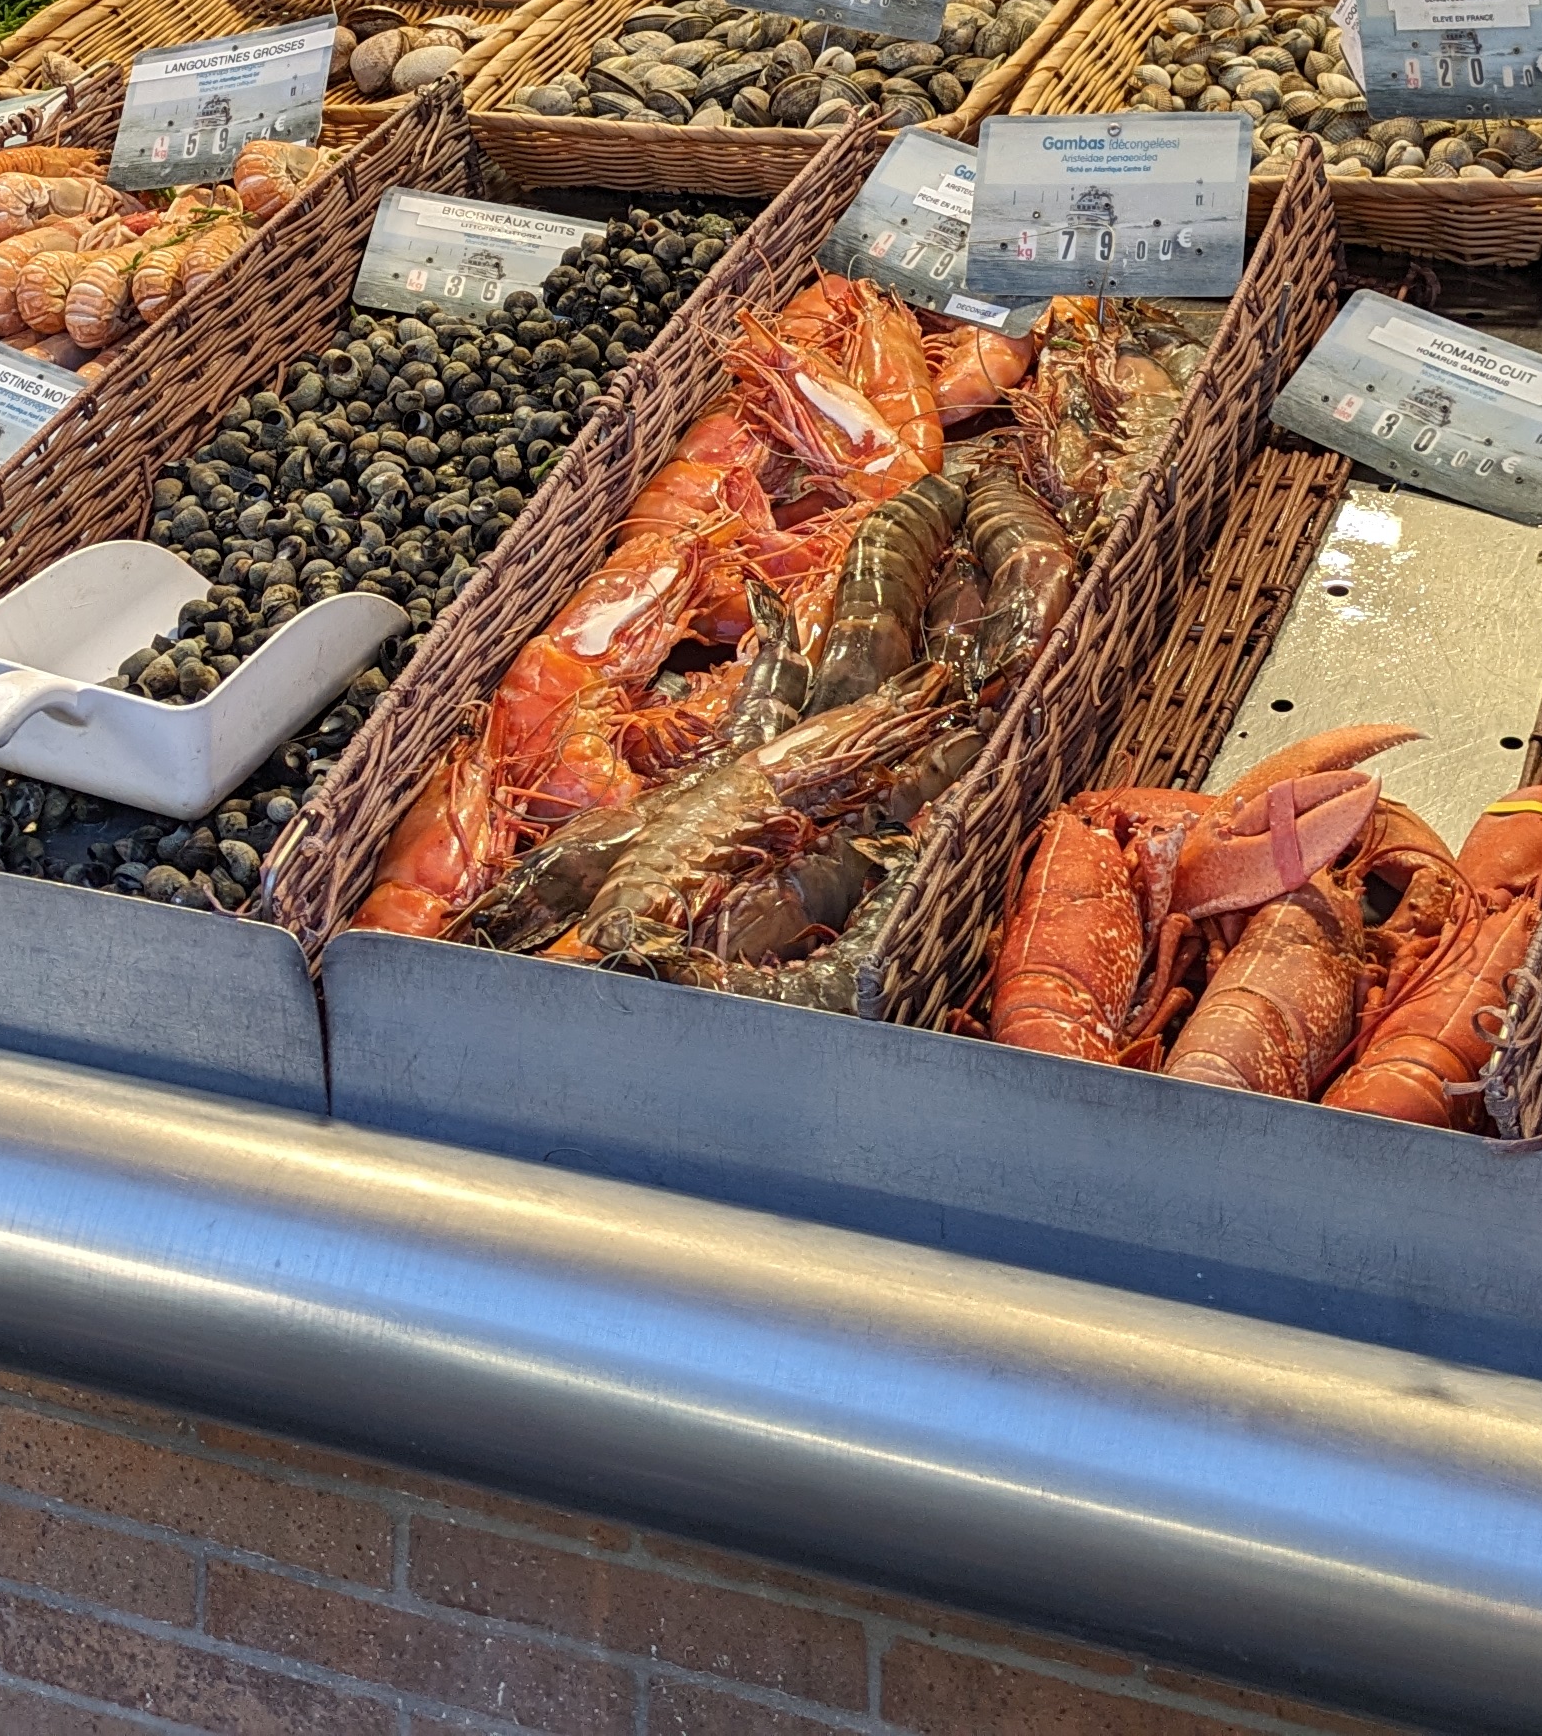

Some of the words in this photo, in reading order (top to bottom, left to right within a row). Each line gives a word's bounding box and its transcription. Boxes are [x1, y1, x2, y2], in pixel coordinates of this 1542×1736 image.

[1432, 14, 1454, 24] ELEVE
[1455, 14, 1466, 22] EN
[1467, 13, 1495, 22] FRANCE
[164, 50, 251, 75] LANGOUSTINES
[253, 37, 307, 60] GROSSES
[1405, 75, 1420, 88] kg
[1042, 135, 1105, 152] Gambas
[1108, 136, 1181, 152] (décongelées)
[153, 147, 167, 160] kg
[1061, 153, 1105, 163] Aristeidae
[441, 206, 531, 230] BIGORNEAUX
[535, 221, 576, 237] CUITS
[1016, 246, 1033, 261] kg
[1415, 345, 1460, 374] HOMARUS
[1459, 364, 1511, 388] GAMMURUS
[1429, 337, 1498, 372] HOMARD
[1497, 362, 1539, 386] CUIT
